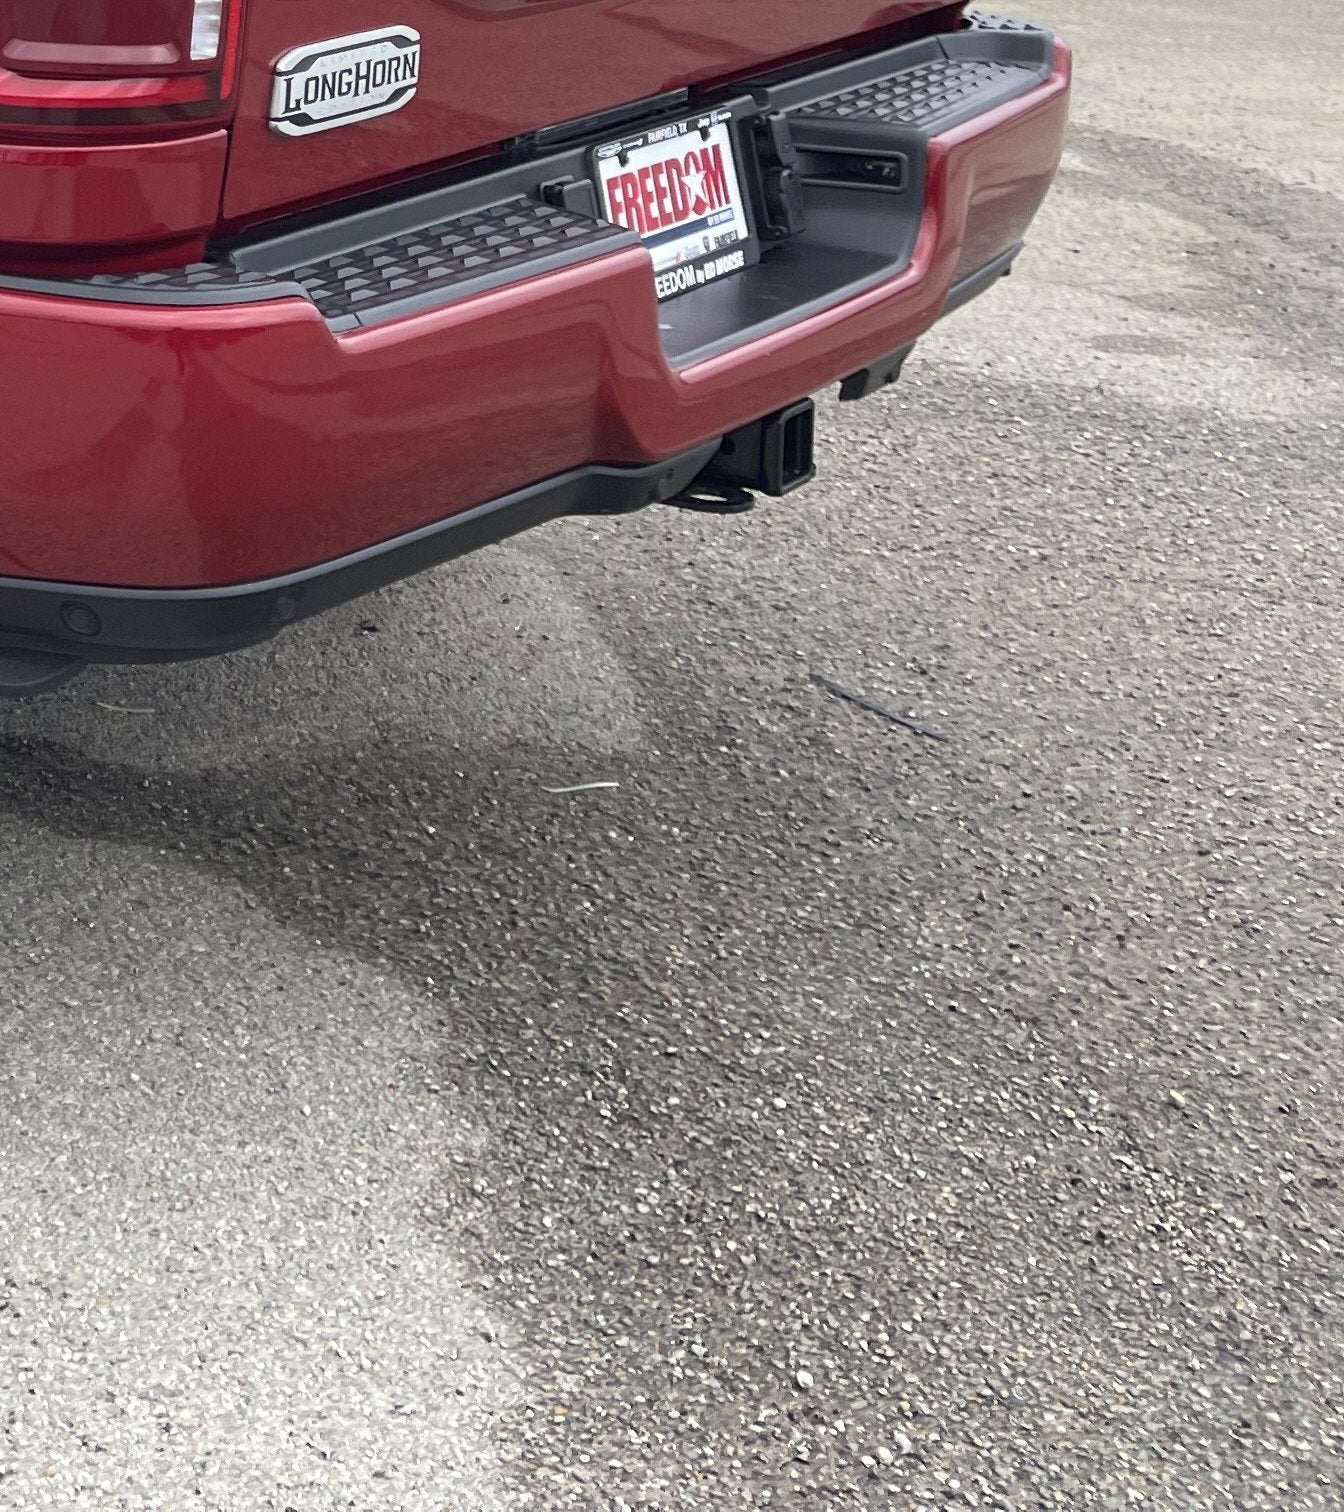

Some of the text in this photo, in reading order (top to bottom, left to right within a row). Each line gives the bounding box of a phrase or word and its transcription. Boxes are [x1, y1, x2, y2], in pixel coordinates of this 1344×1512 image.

[606, 143, 731, 235] FREEDOM
[654, 264, 697, 299] EEDOM
[703, 261, 716, 280] ED
[715, 249, 745, 276] MORSE
